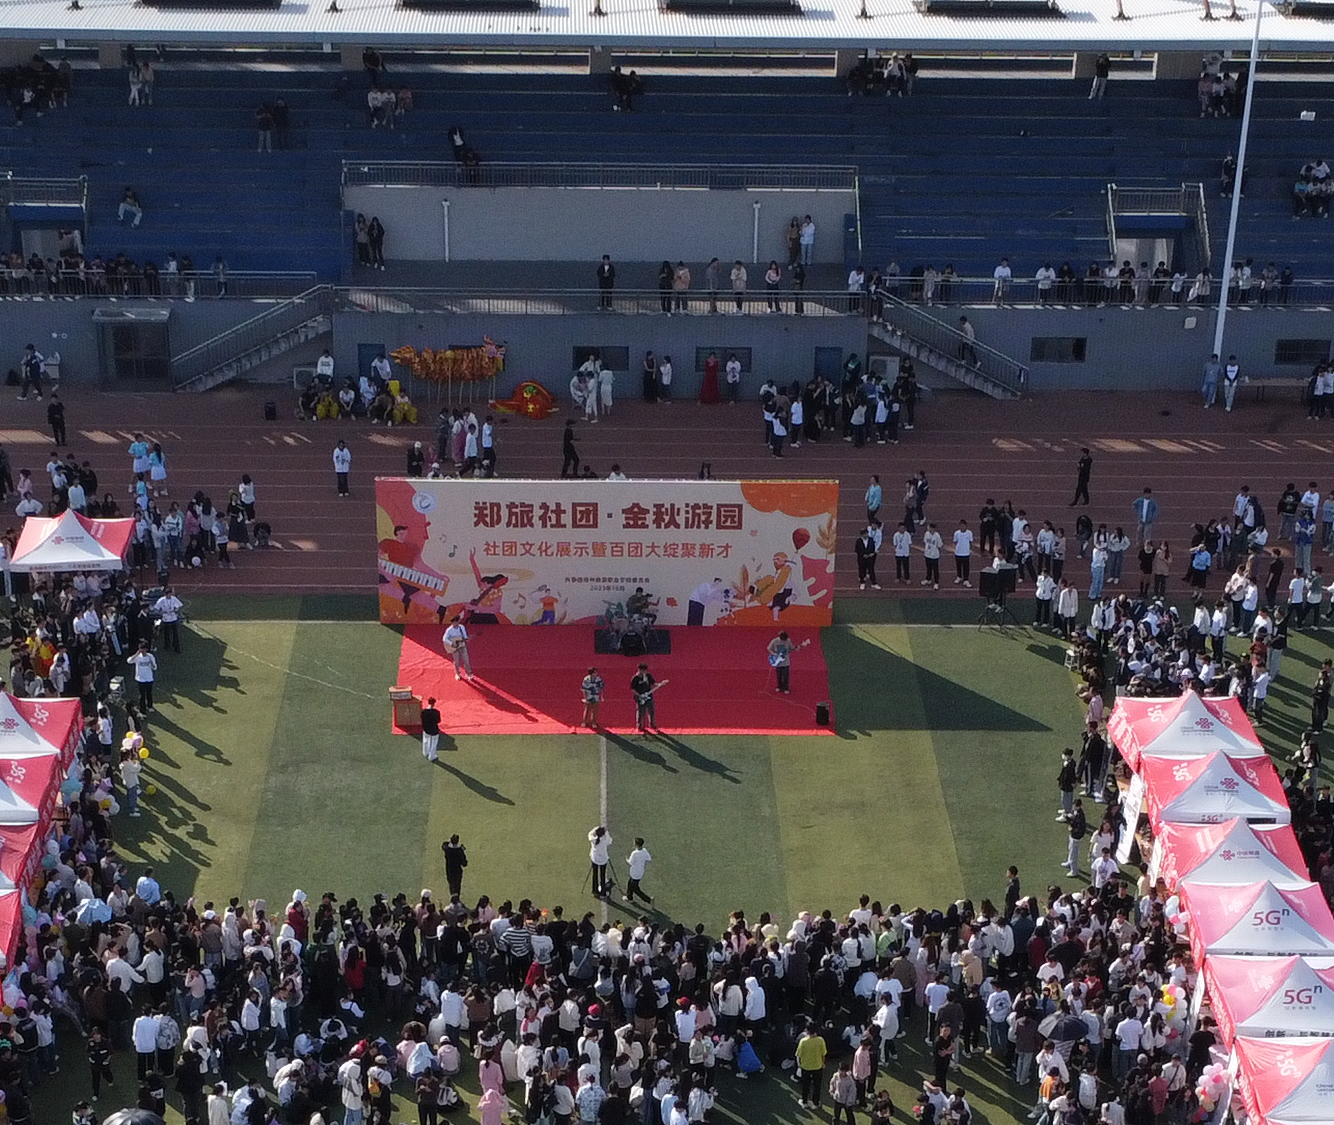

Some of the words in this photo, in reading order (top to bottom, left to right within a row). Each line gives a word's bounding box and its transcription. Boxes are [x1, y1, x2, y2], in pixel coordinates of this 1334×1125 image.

[473, 502, 743, 530] 郑旅社团·金秋游园
